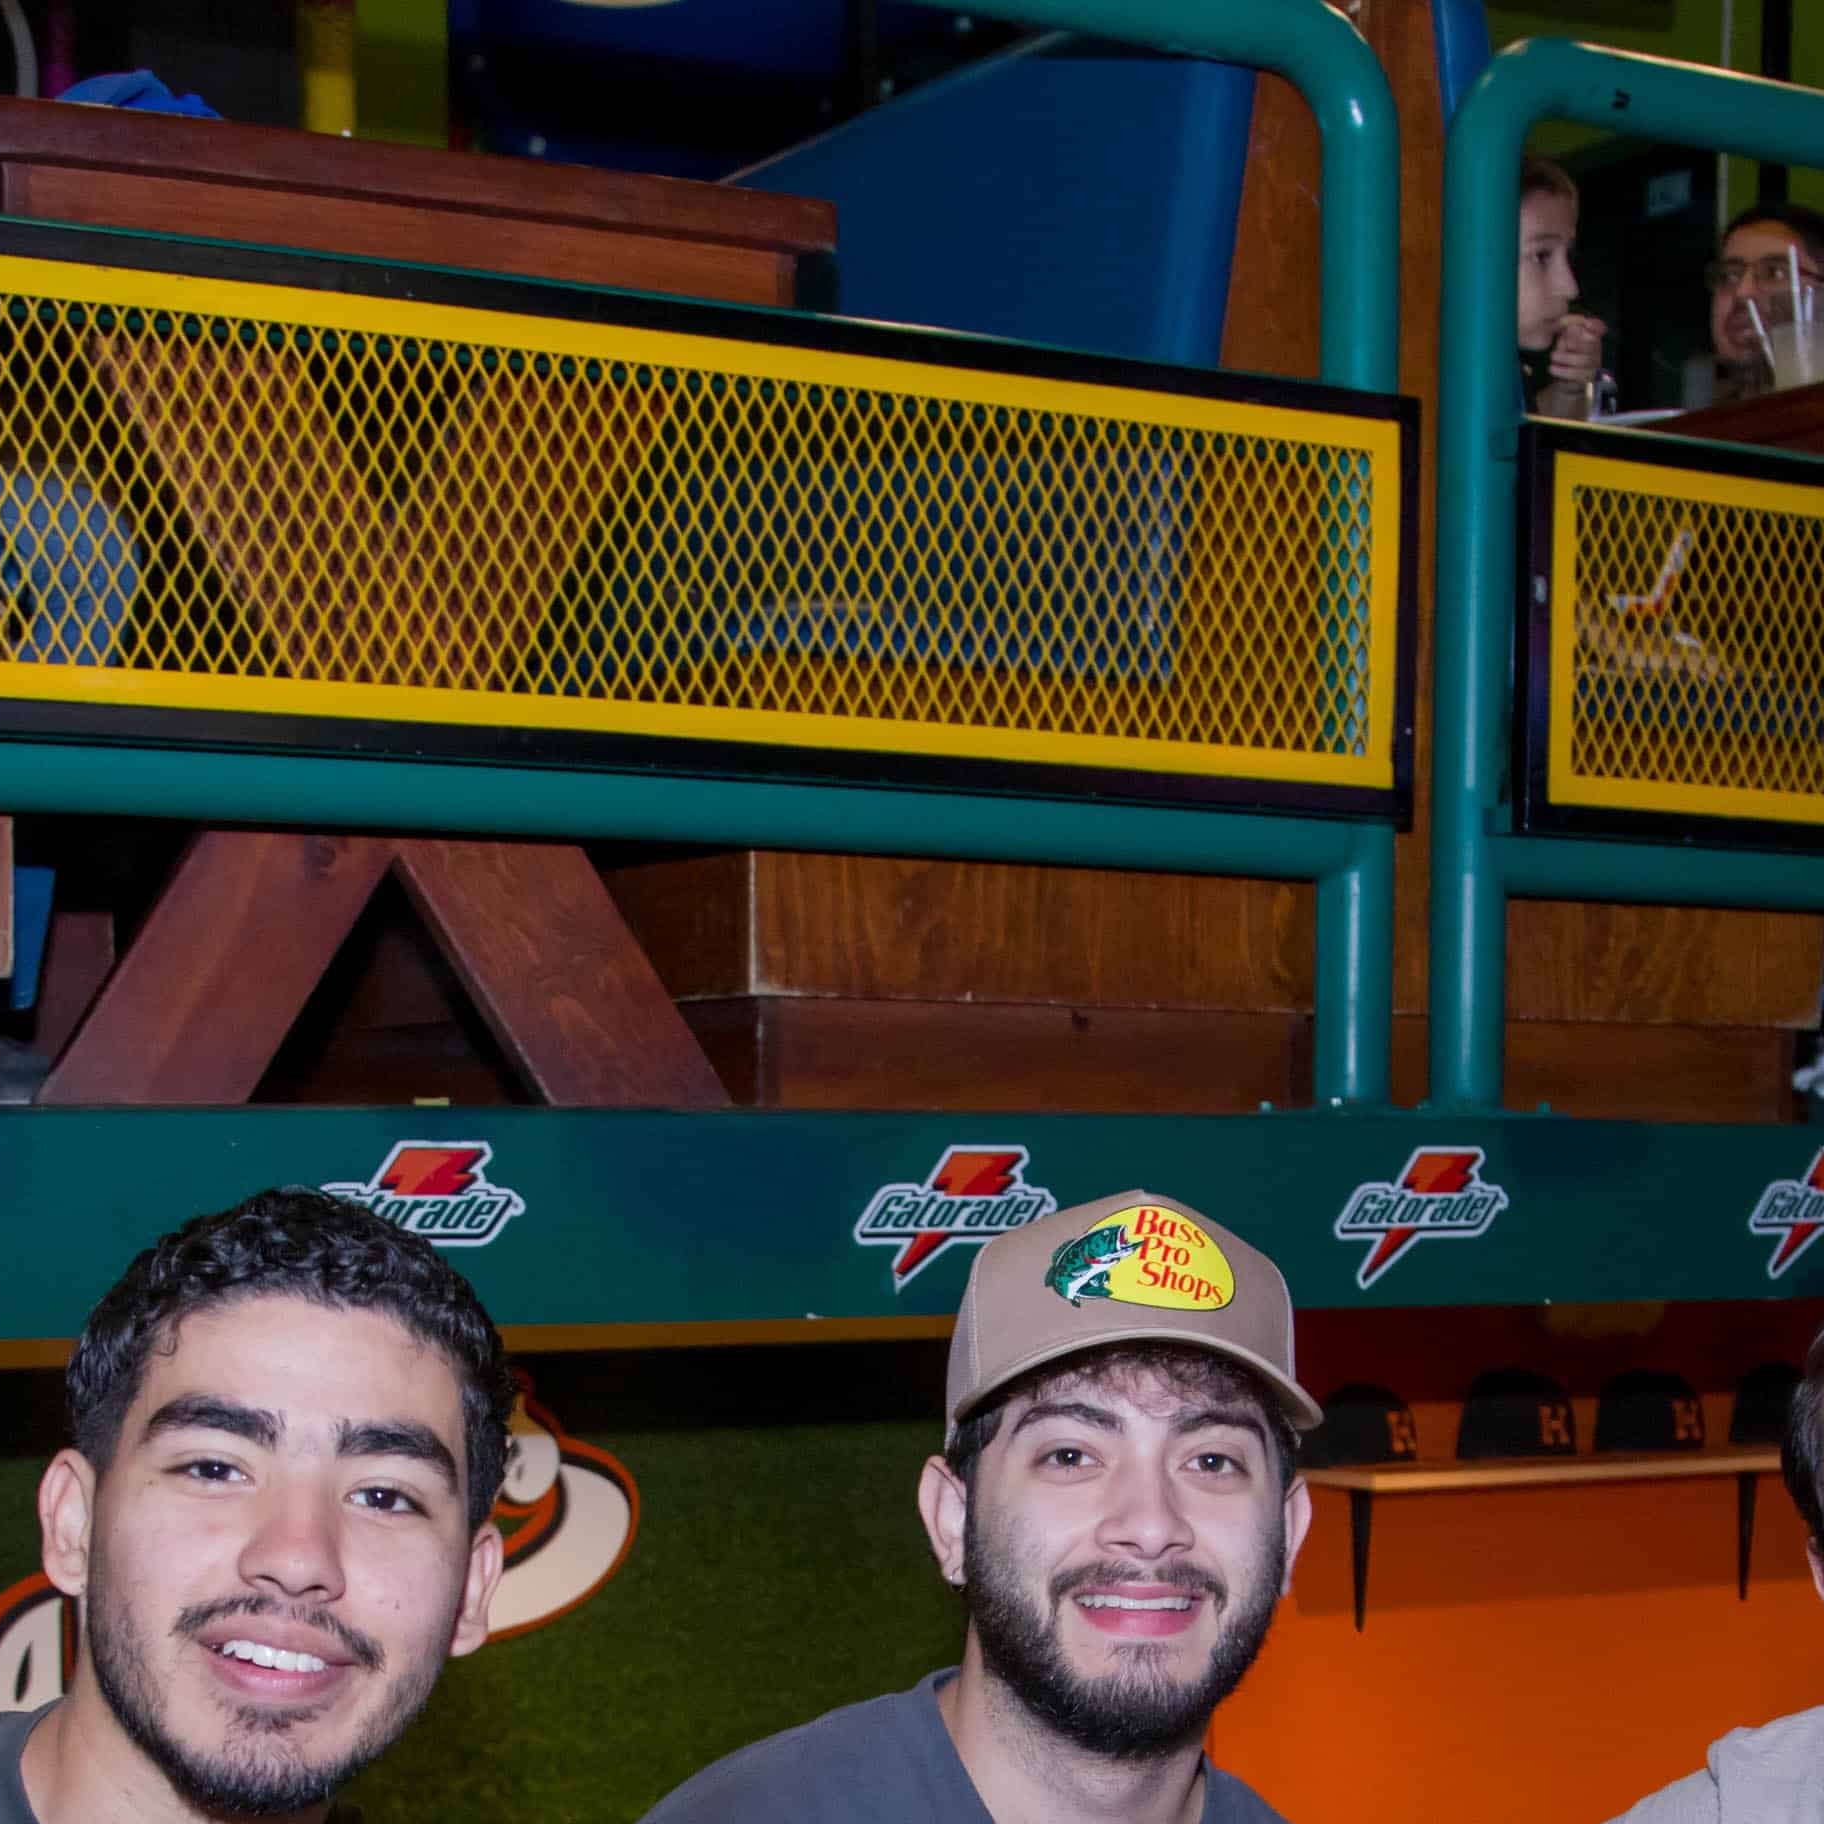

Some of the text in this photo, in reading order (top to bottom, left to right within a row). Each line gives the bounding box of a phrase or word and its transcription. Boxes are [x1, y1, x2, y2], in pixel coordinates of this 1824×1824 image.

[336, 1193, 498, 1231] torade
[870, 1194, 1033, 1229] Gatorade
[1349, 1192, 1489, 1225] Gatorade
[1133, 1208, 1206, 1249] Bass
[1138, 1235, 1191, 1267] Pro
[1136, 1260, 1224, 1305] Shops
